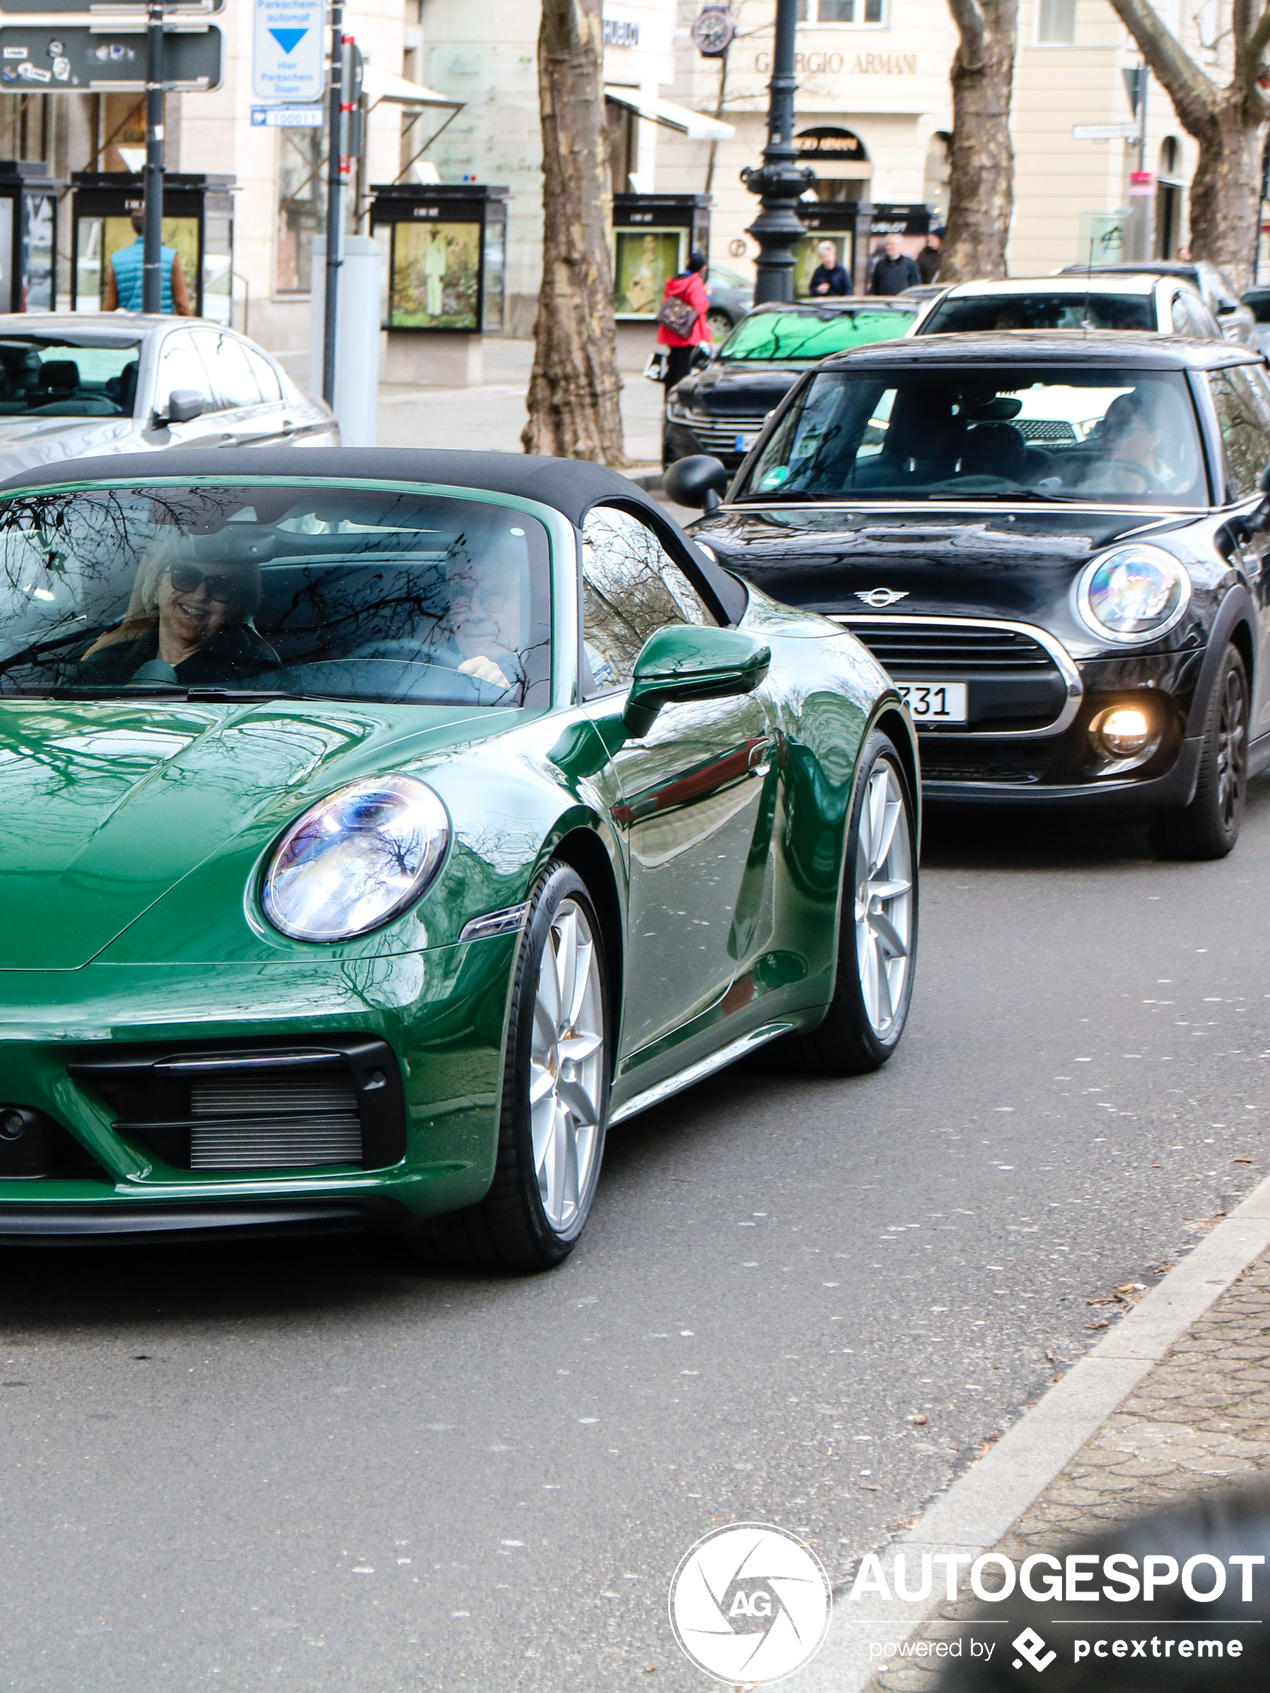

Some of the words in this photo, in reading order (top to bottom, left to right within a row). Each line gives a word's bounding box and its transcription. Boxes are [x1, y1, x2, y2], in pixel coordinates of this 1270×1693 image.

[266, 13, 310, 22] automat
[754, 52, 843, 74] GRGIO
[849, 53, 917, 75] ARMANI
[261, 73, 313, 81] Parkschein
[871, 221, 907, 233] UBLOT
